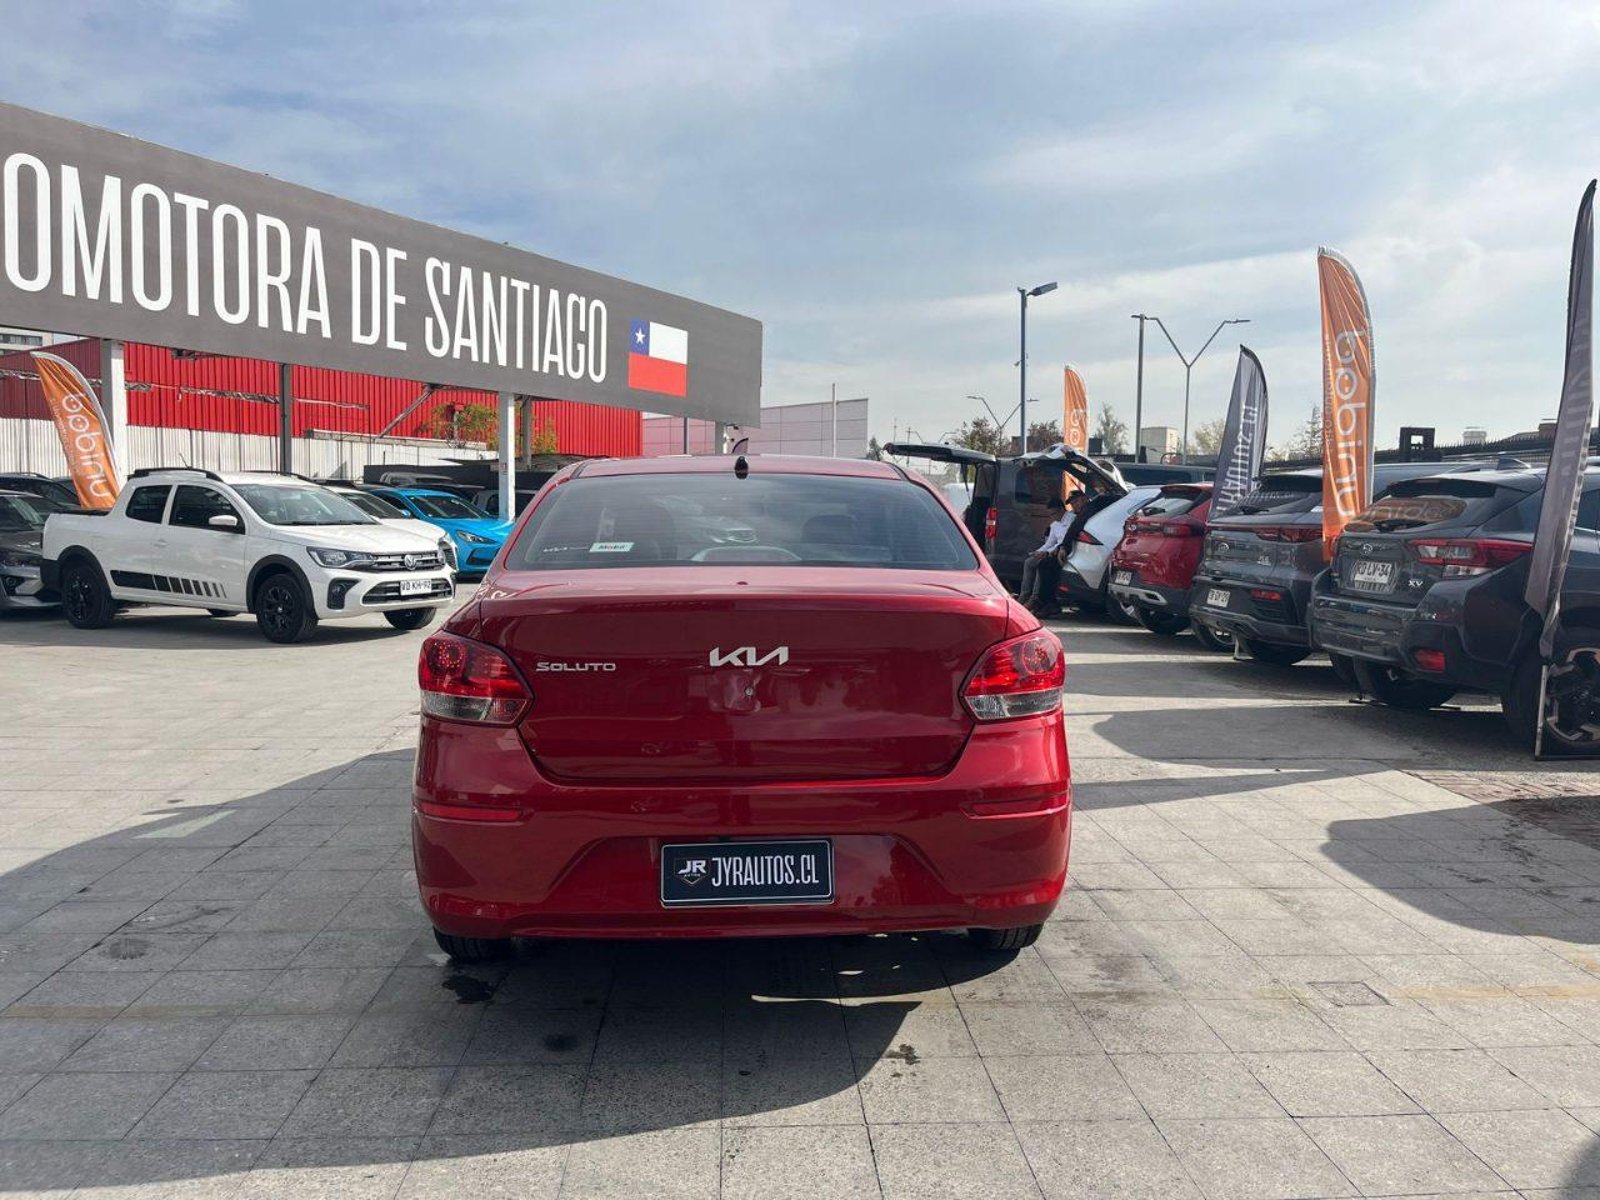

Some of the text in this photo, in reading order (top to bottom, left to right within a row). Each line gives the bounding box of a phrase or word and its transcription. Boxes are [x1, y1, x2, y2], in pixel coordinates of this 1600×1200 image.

[350, 238, 408, 352] DE
[424, 256, 608, 384] SANTIAGO
[1408, 579, 1424, 588] XV
[709, 646, 789, 667] KIA
[536, 661, 617, 672] SOLUTO
[678, 860, 707, 875] JR
[711, 854, 819, 887] JYRAUTOS.CL
